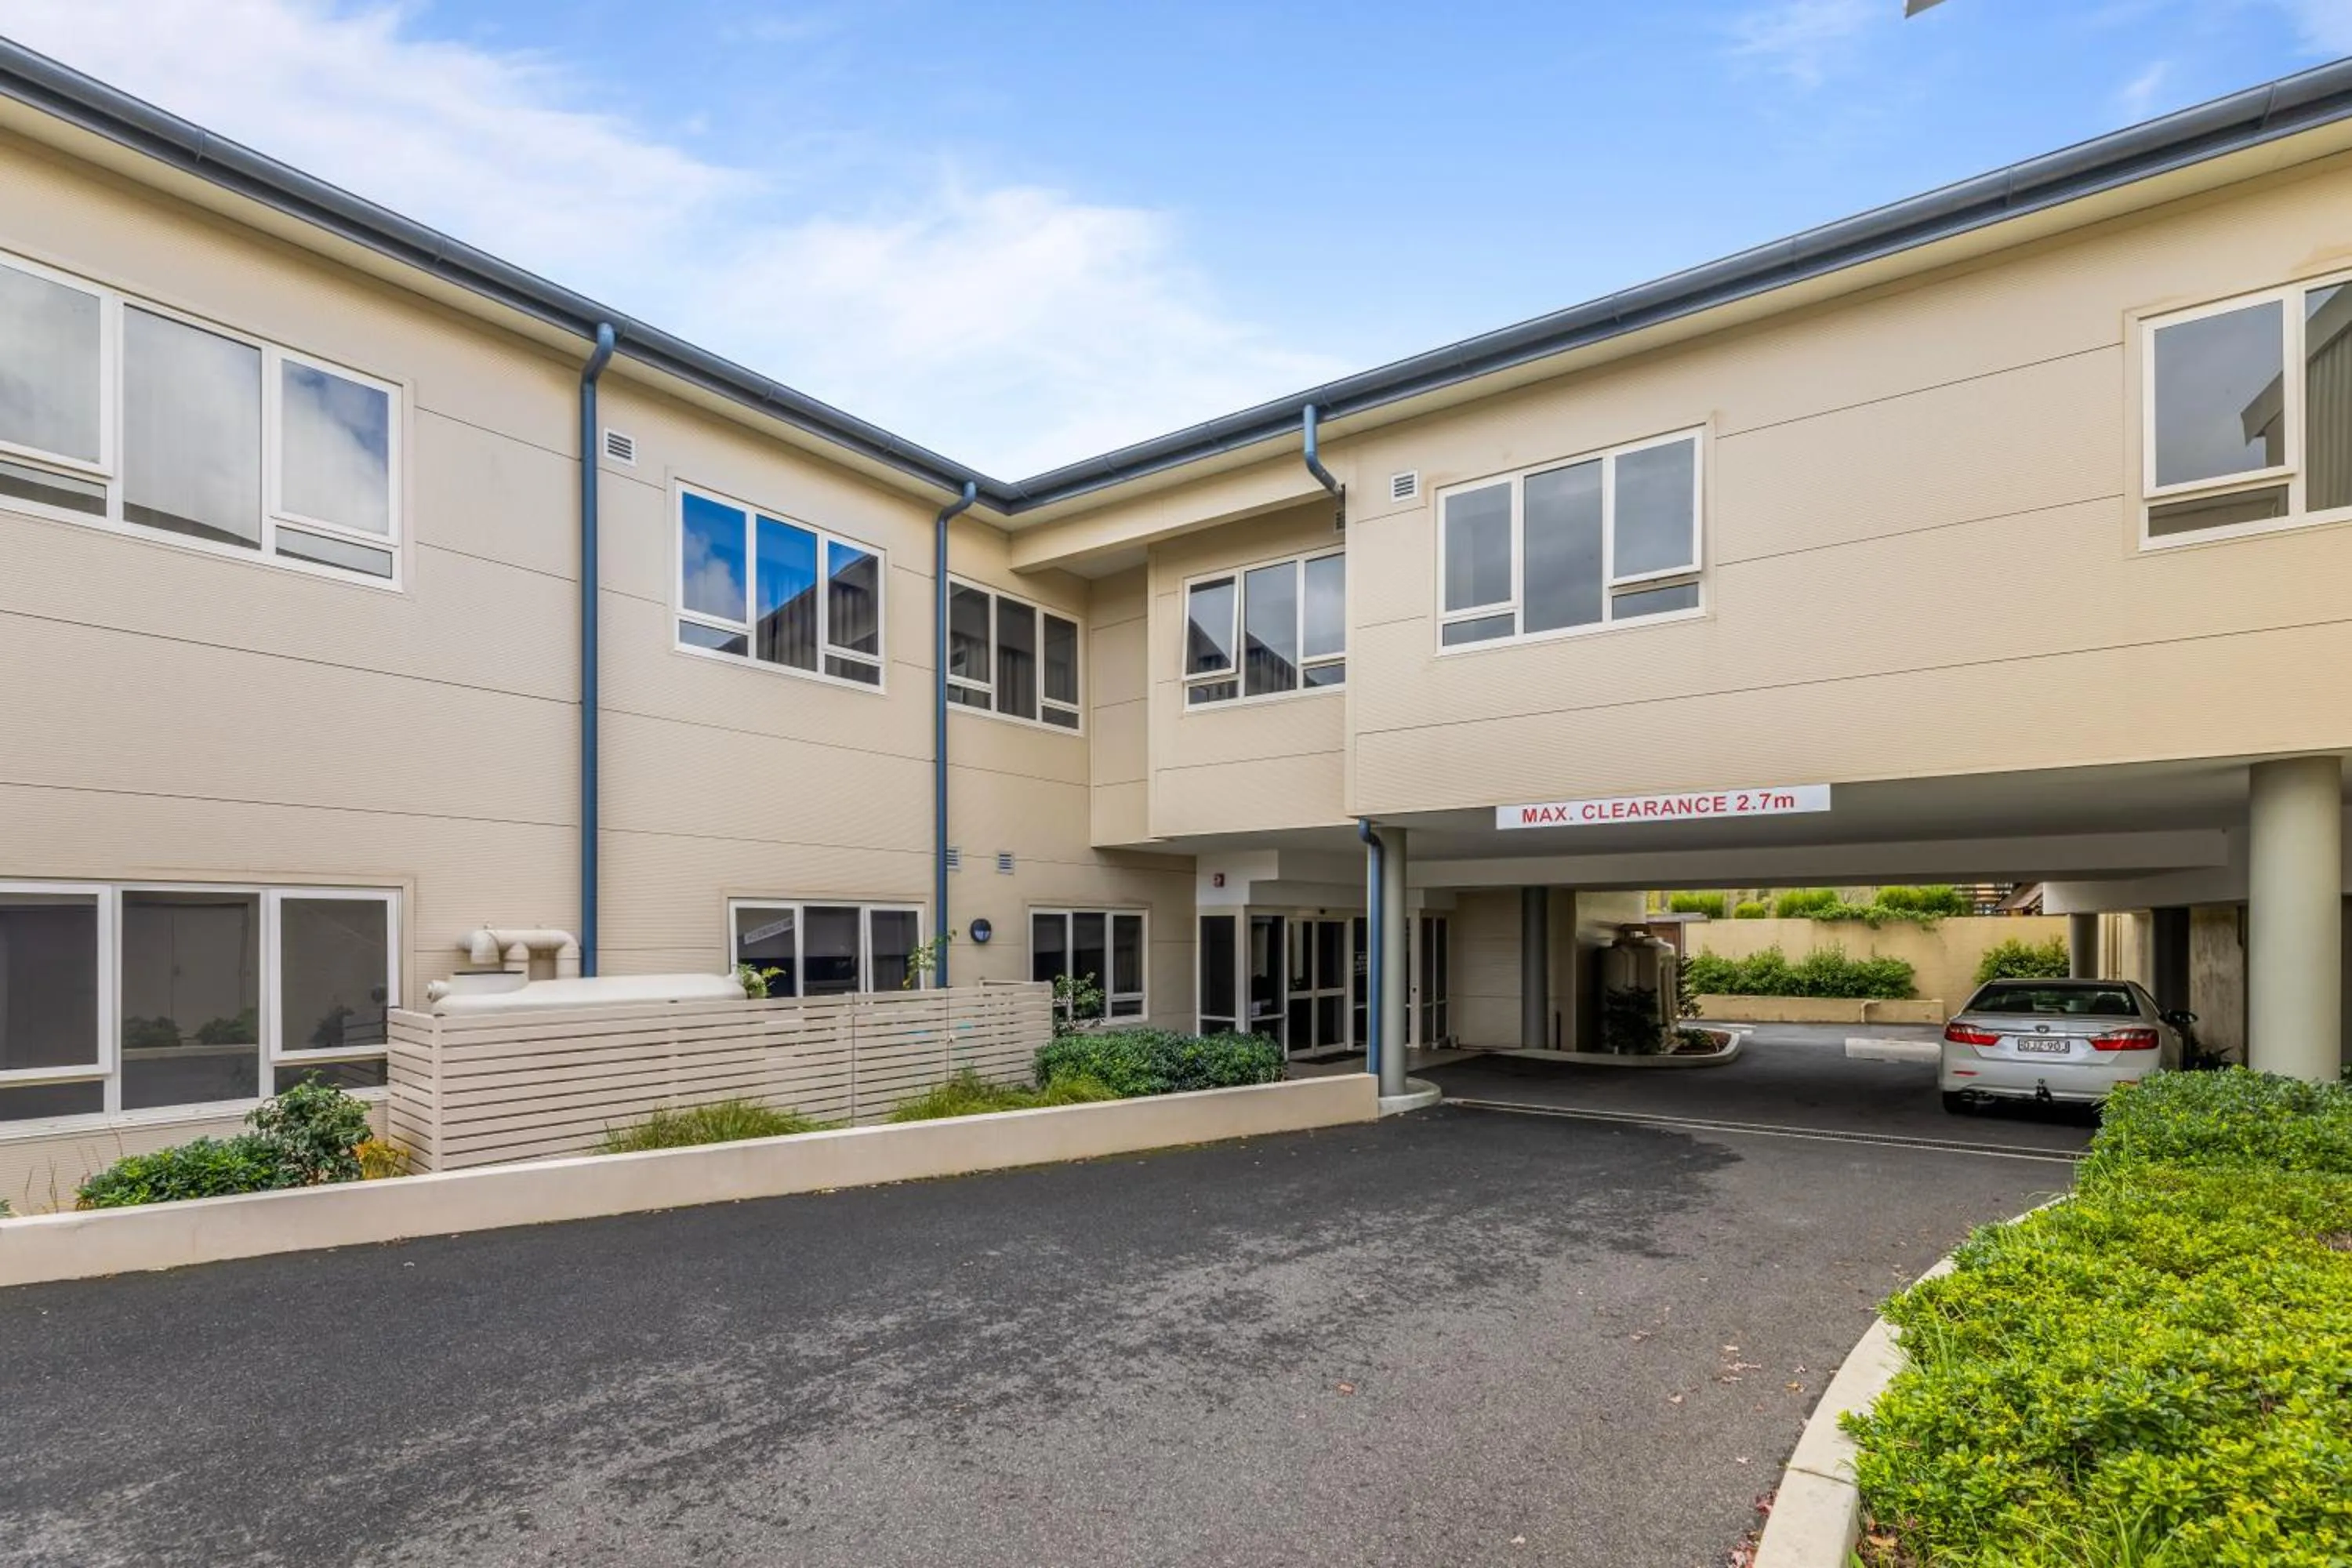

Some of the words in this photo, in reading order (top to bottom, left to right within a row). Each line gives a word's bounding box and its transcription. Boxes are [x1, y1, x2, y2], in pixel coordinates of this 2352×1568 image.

[1522, 806, 1573, 823] MAX.
[1581, 795, 1727, 820] CLEARANCE
[1736, 793, 1795, 811] 2.7m
